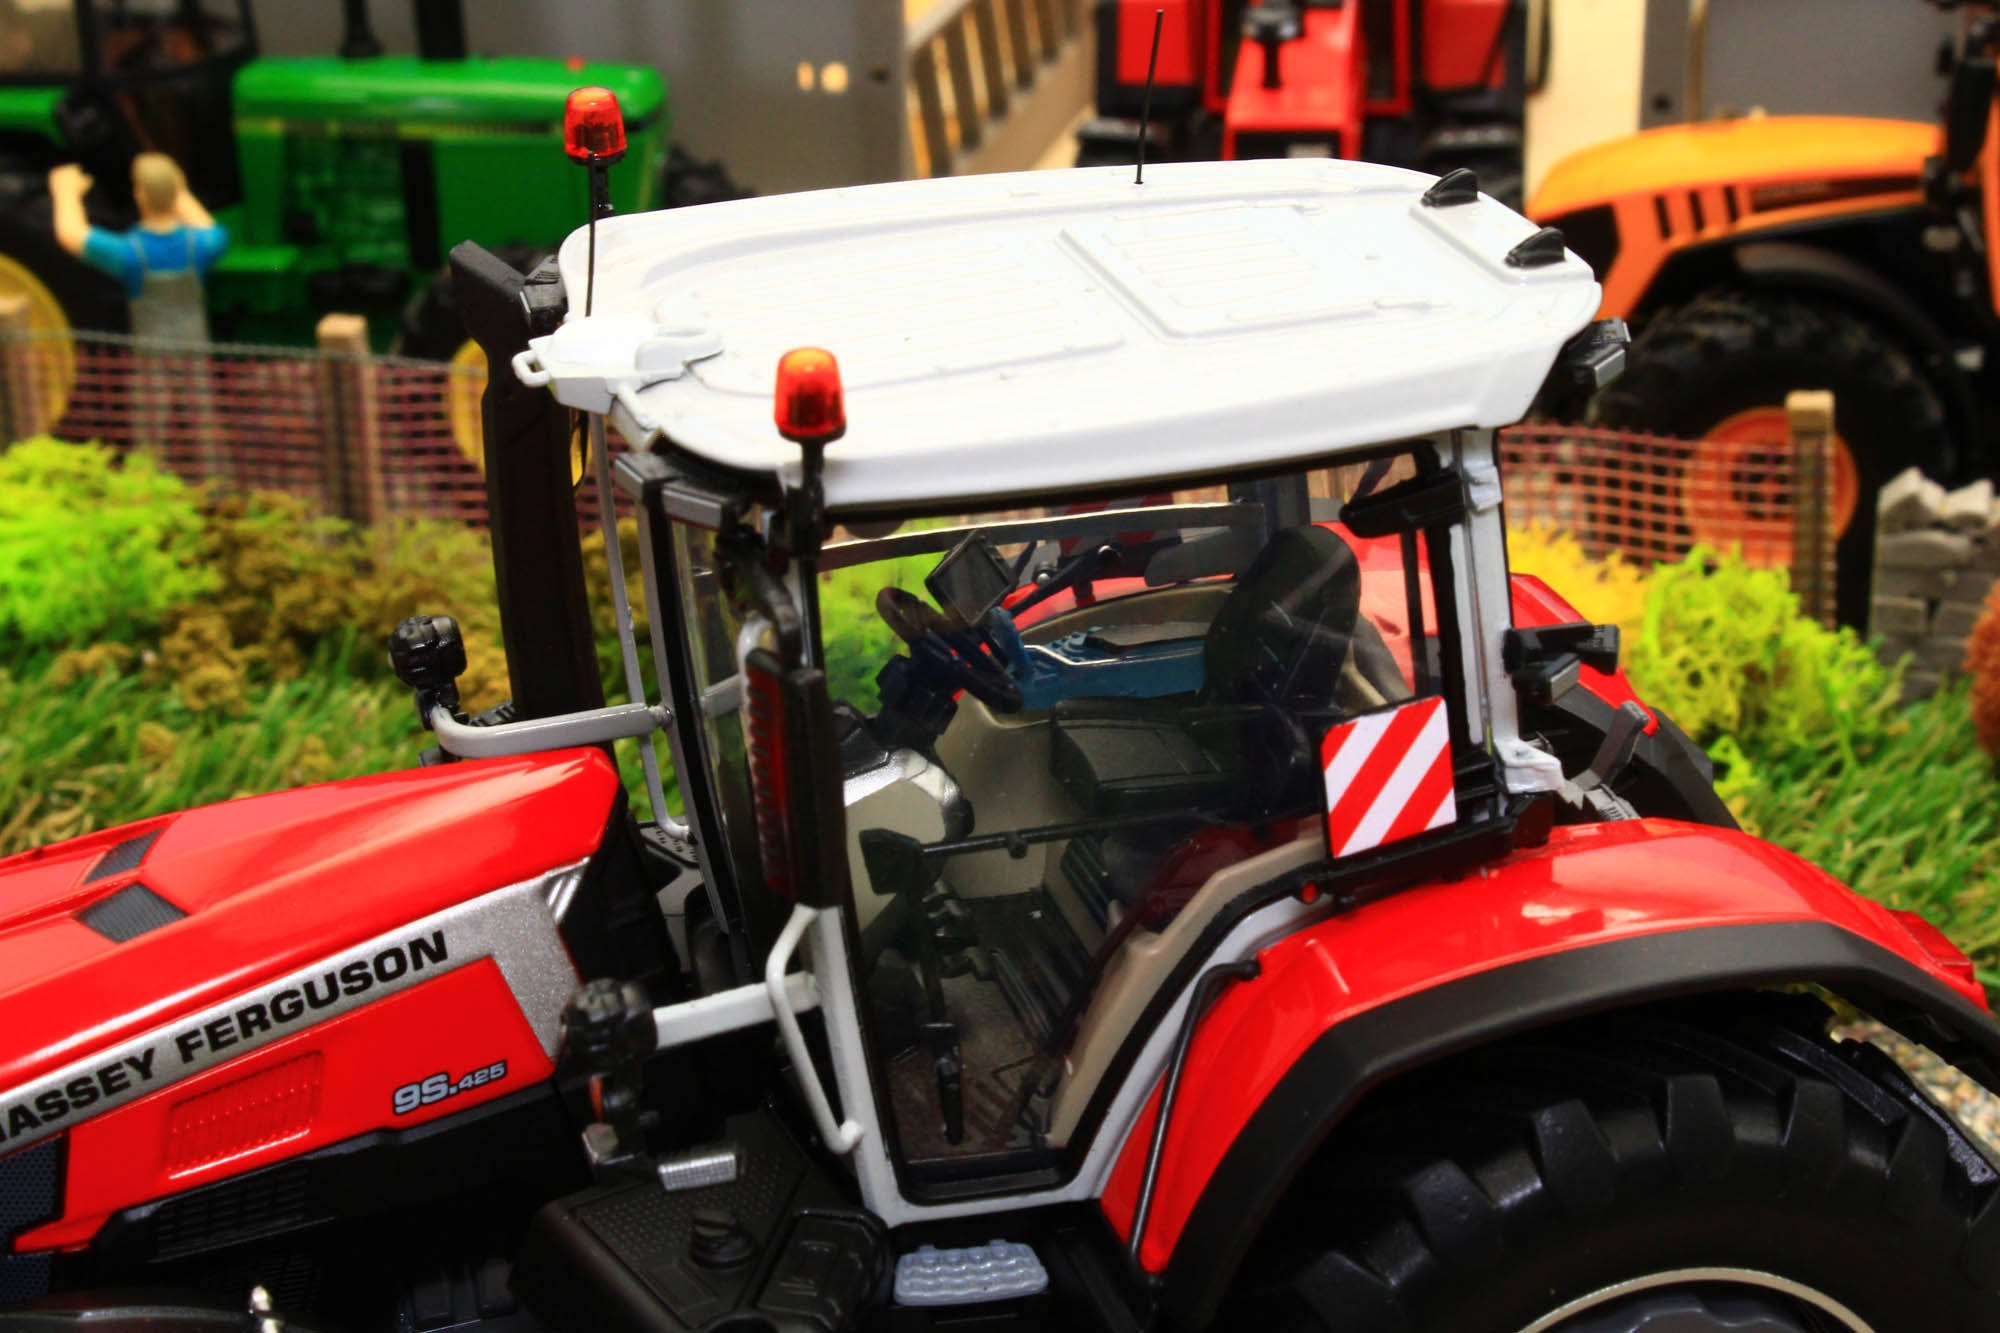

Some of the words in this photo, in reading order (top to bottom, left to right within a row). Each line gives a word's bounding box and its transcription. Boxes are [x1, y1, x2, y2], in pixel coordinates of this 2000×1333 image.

[0, 1049, 157, 1142] ASSEY
[175, 931, 449, 1063] FERGUSON
[393, 1060, 507, 1114] 9S.425
